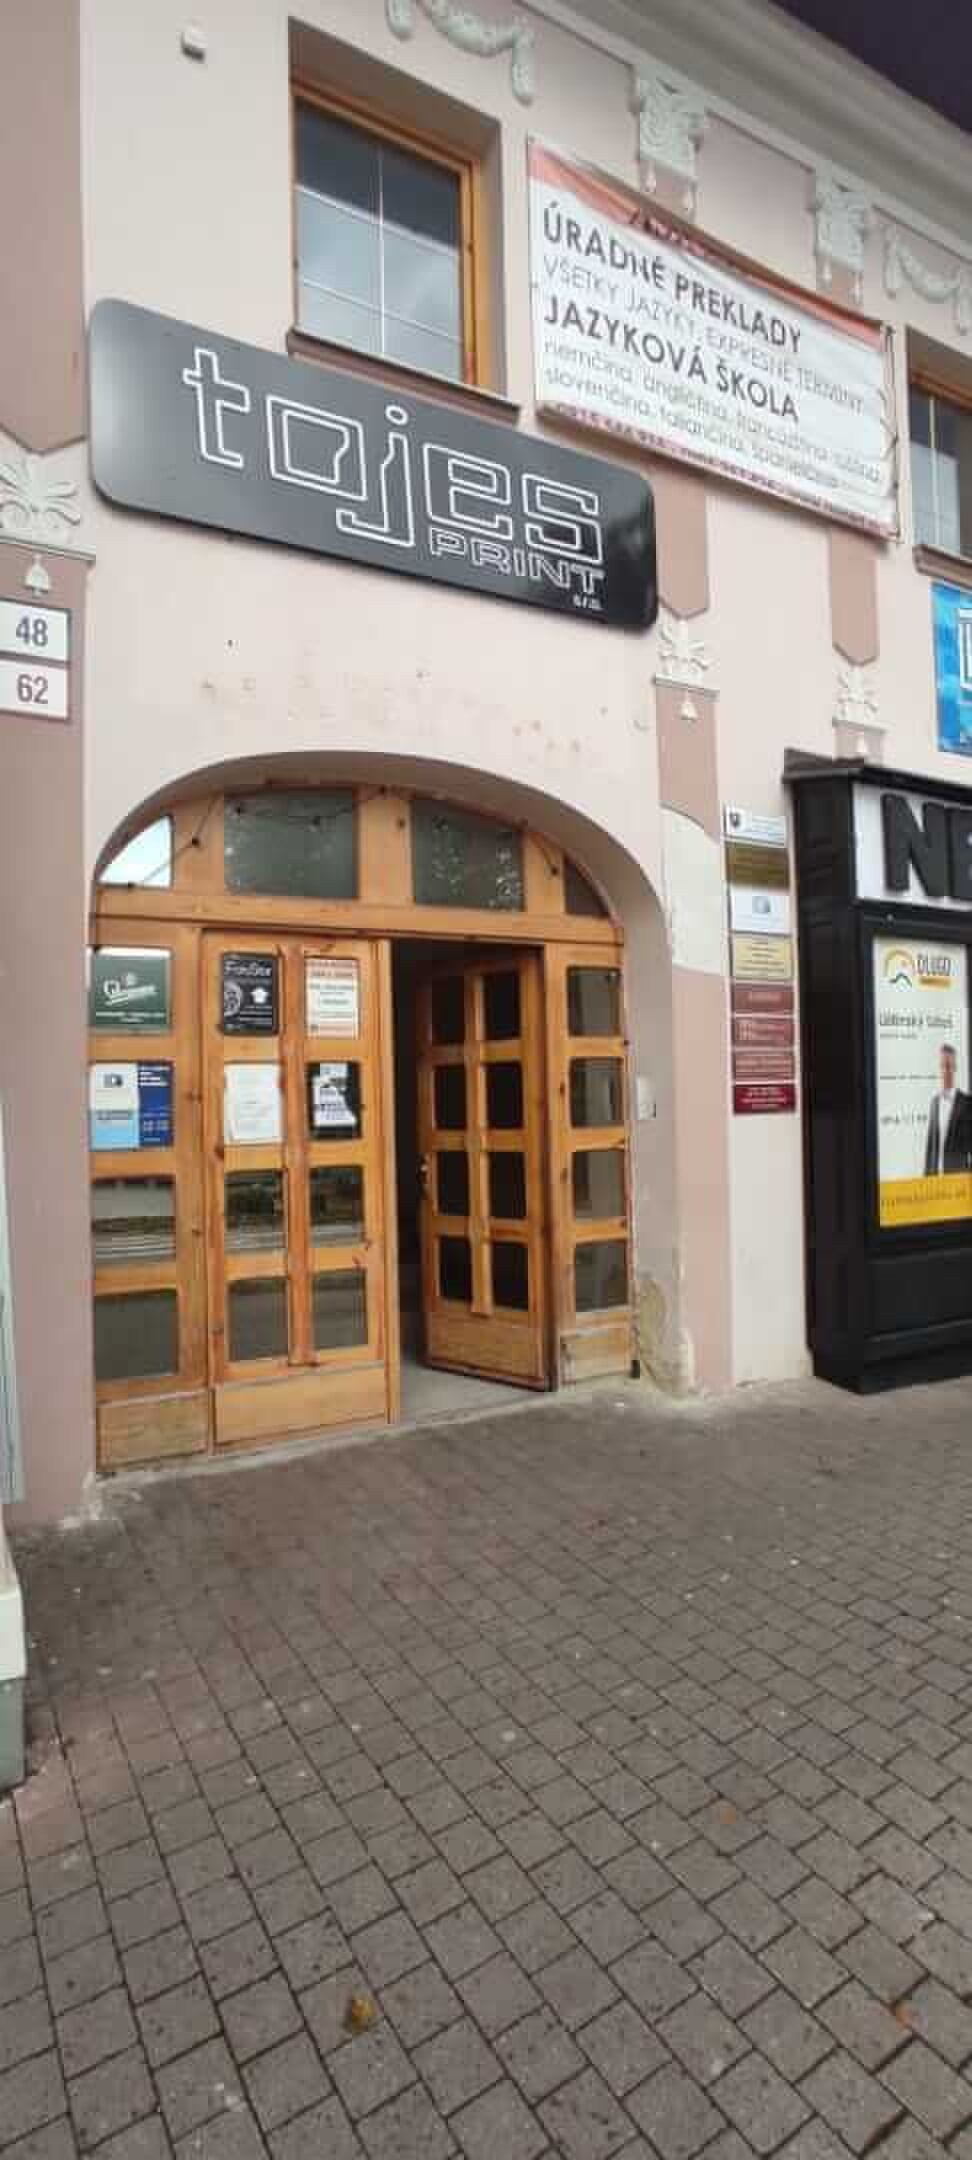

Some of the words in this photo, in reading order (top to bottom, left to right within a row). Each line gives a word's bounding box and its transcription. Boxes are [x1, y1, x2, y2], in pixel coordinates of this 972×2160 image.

[543, 200, 668, 290] ÚRADNÉ
[675, 273, 801, 354] PREKLADY
[543, 254, 619, 301] VŠETKY
[543, 295, 707, 385] JAZYKOVÁ
[715, 357, 800, 424] ŠKOLA
[182, 347, 604, 564] tojes
[430, 527, 605, 595] PRINT
[15, 616, 49, 648] 48
[17, 672, 49, 705] 62
